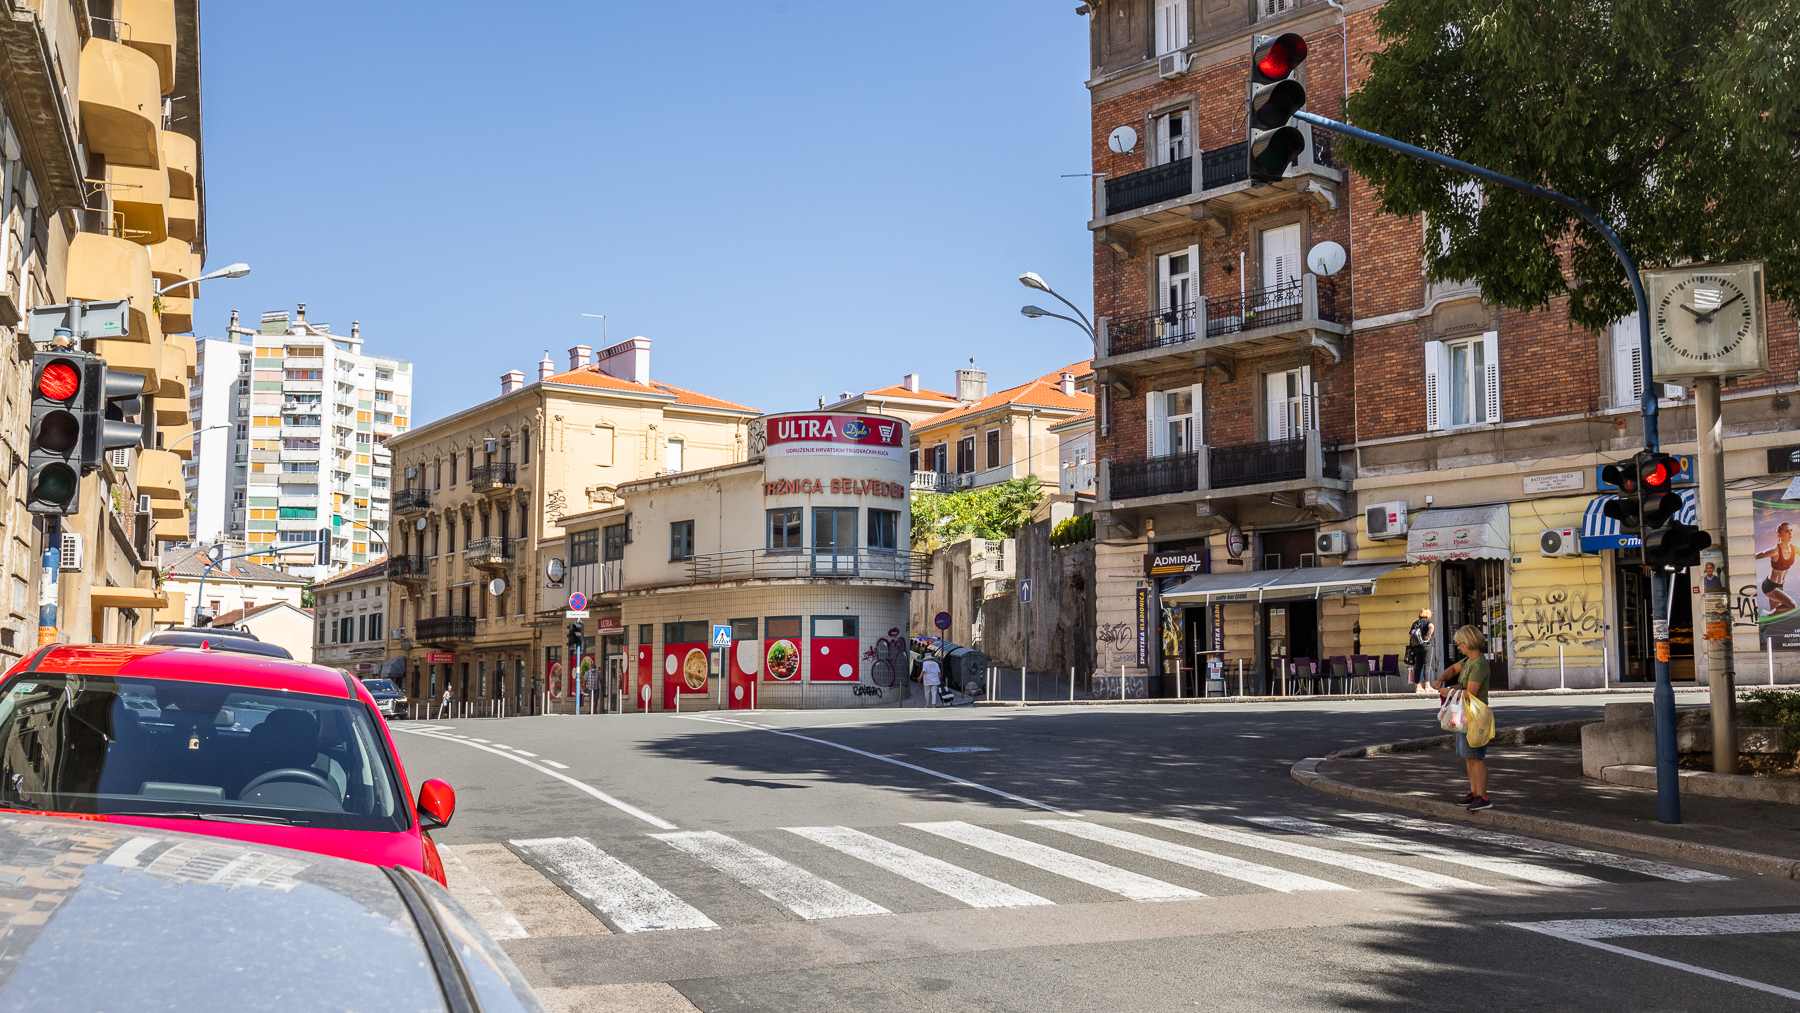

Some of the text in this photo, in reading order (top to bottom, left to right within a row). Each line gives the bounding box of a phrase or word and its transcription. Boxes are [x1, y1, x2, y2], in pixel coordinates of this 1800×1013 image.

[778, 420, 838, 440] ULTRA
[762, 479, 905, 498] TRŽNICA BELVEDER
[1154, 554, 1201, 566] ADMIRAL
[601, 620, 612, 628] ULTRA
